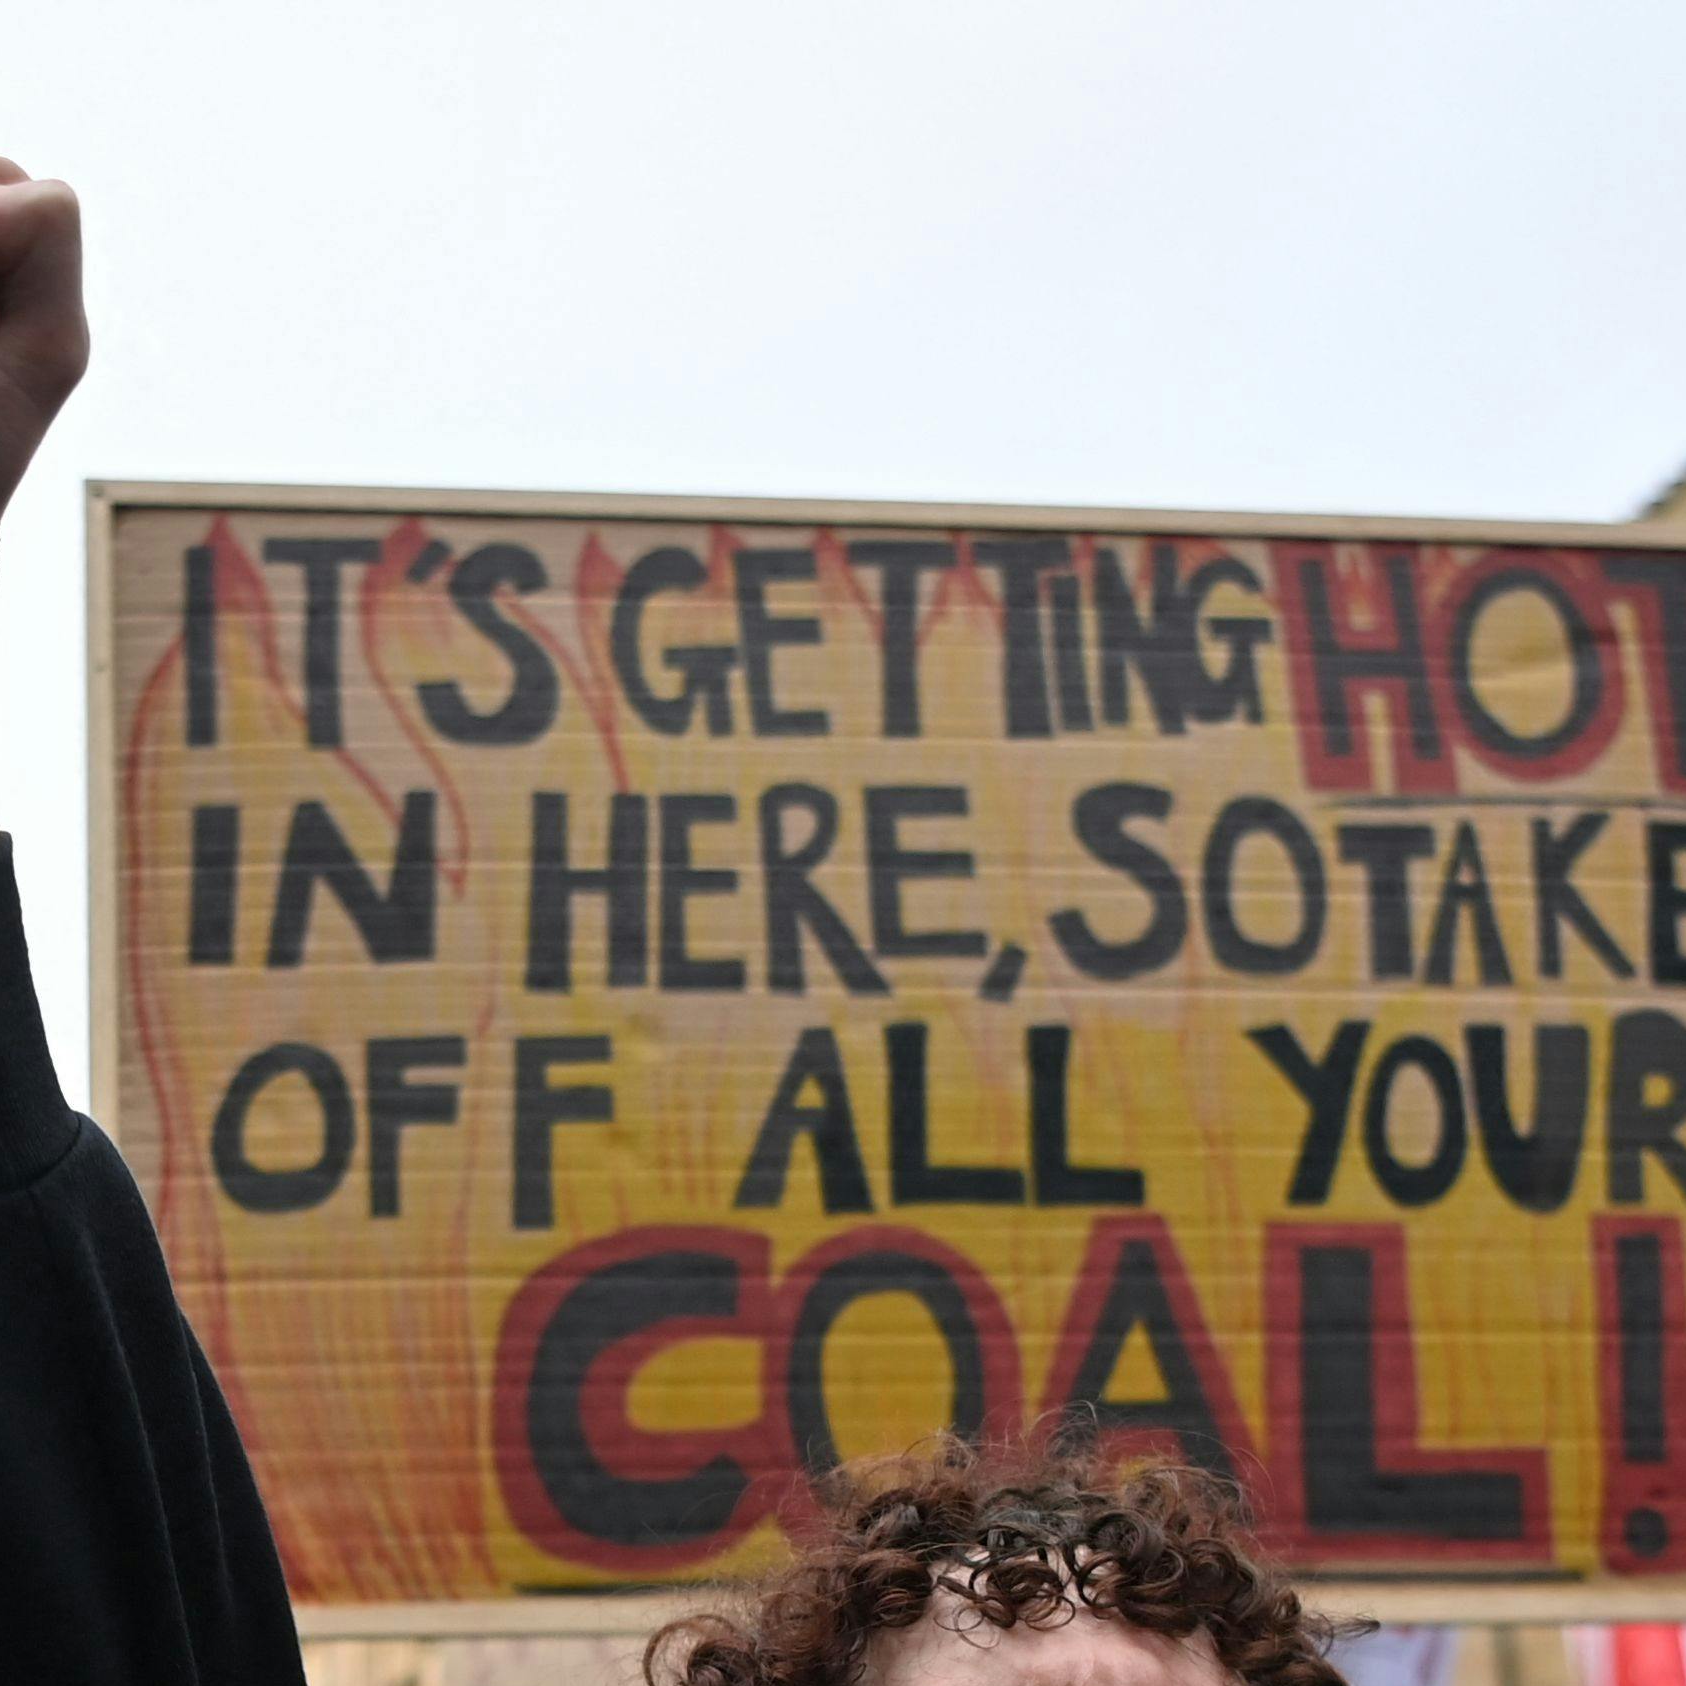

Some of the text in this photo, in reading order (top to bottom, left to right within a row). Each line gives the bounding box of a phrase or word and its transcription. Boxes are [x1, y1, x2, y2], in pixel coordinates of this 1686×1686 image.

[186, 539, 560, 750] IT'S
[607, 540, 1275, 745] GETTING
[186, 792, 437, 968] IN
[523, 777, 1027, 1002] HERE,
[210, 1034, 615, 1230] OFF
[733, 1021, 1146, 1217] ALL
